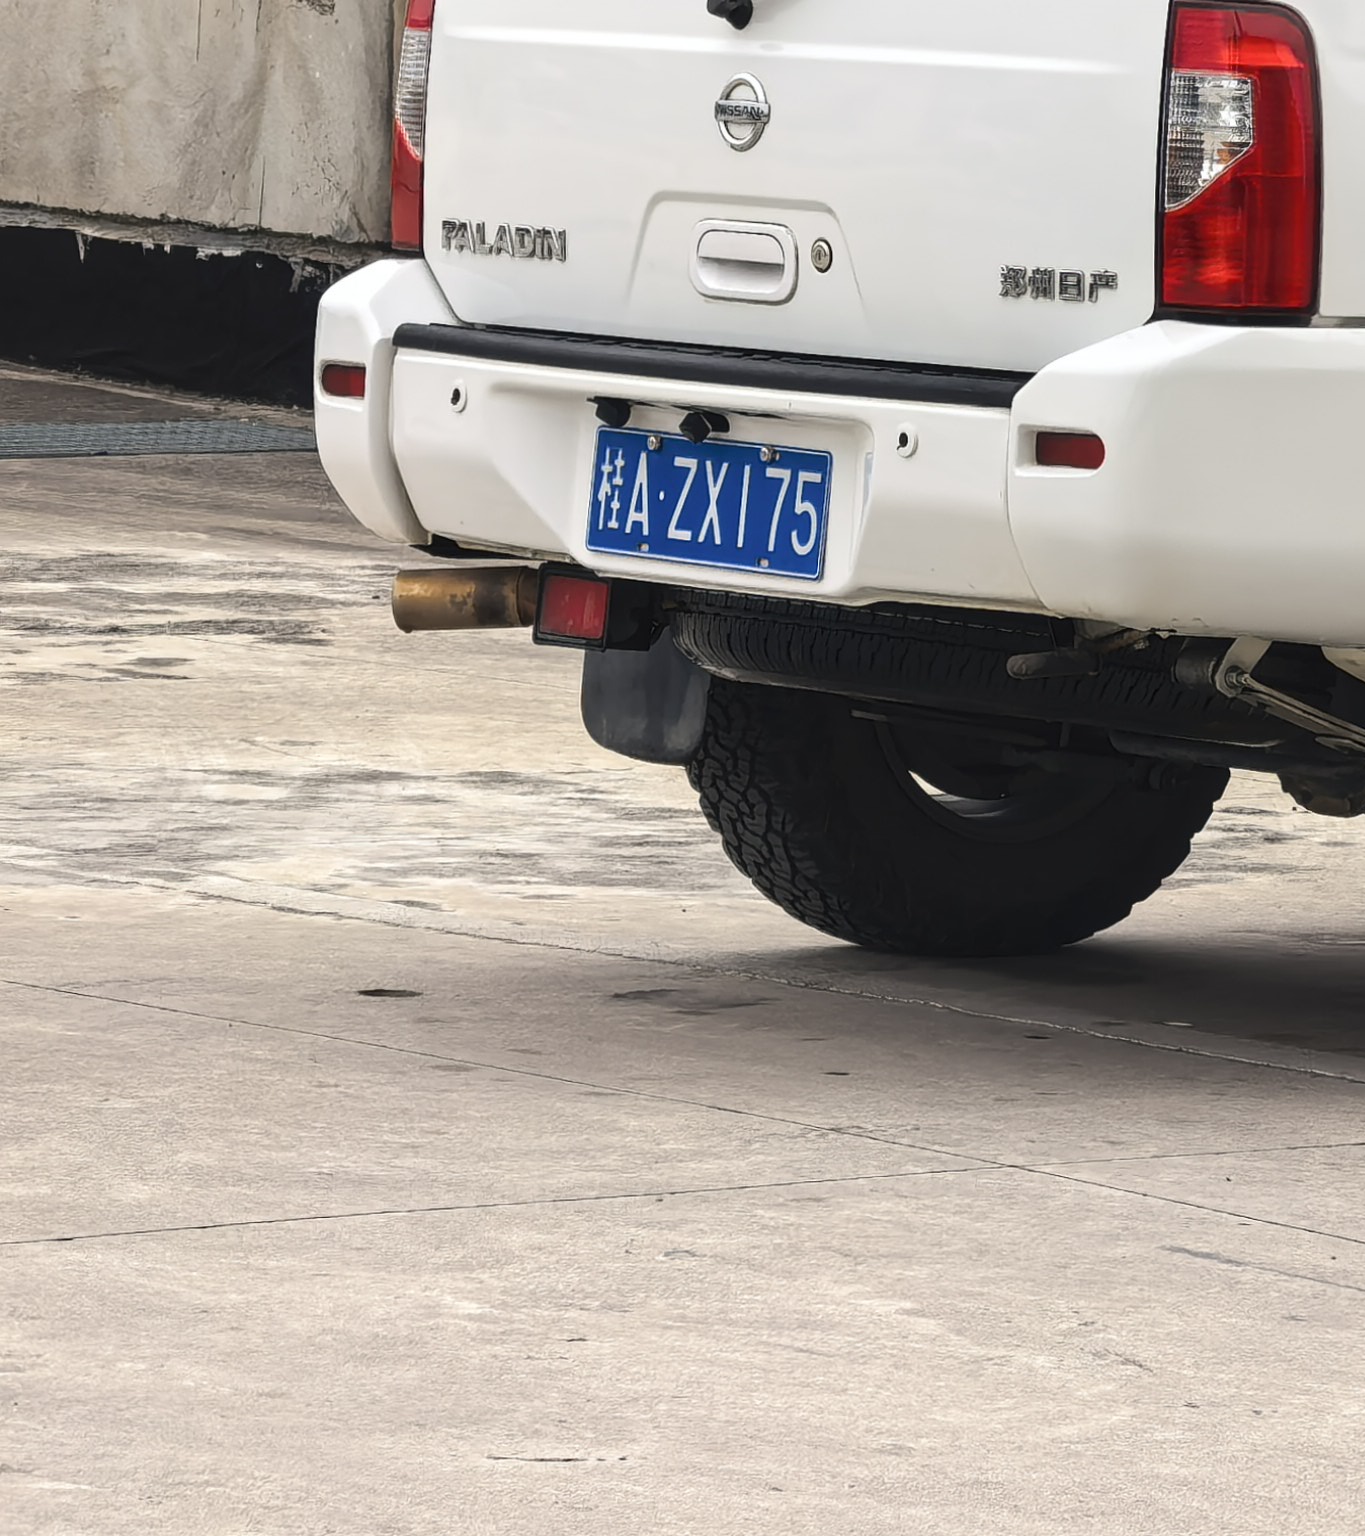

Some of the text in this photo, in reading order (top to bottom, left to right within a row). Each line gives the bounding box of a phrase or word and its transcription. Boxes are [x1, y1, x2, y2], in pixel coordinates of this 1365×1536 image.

[717, 103, 765, 121] NISSAN
[441, 218, 567, 263] PALADIN
[999, 264, 1118, 303] 郑州日产
